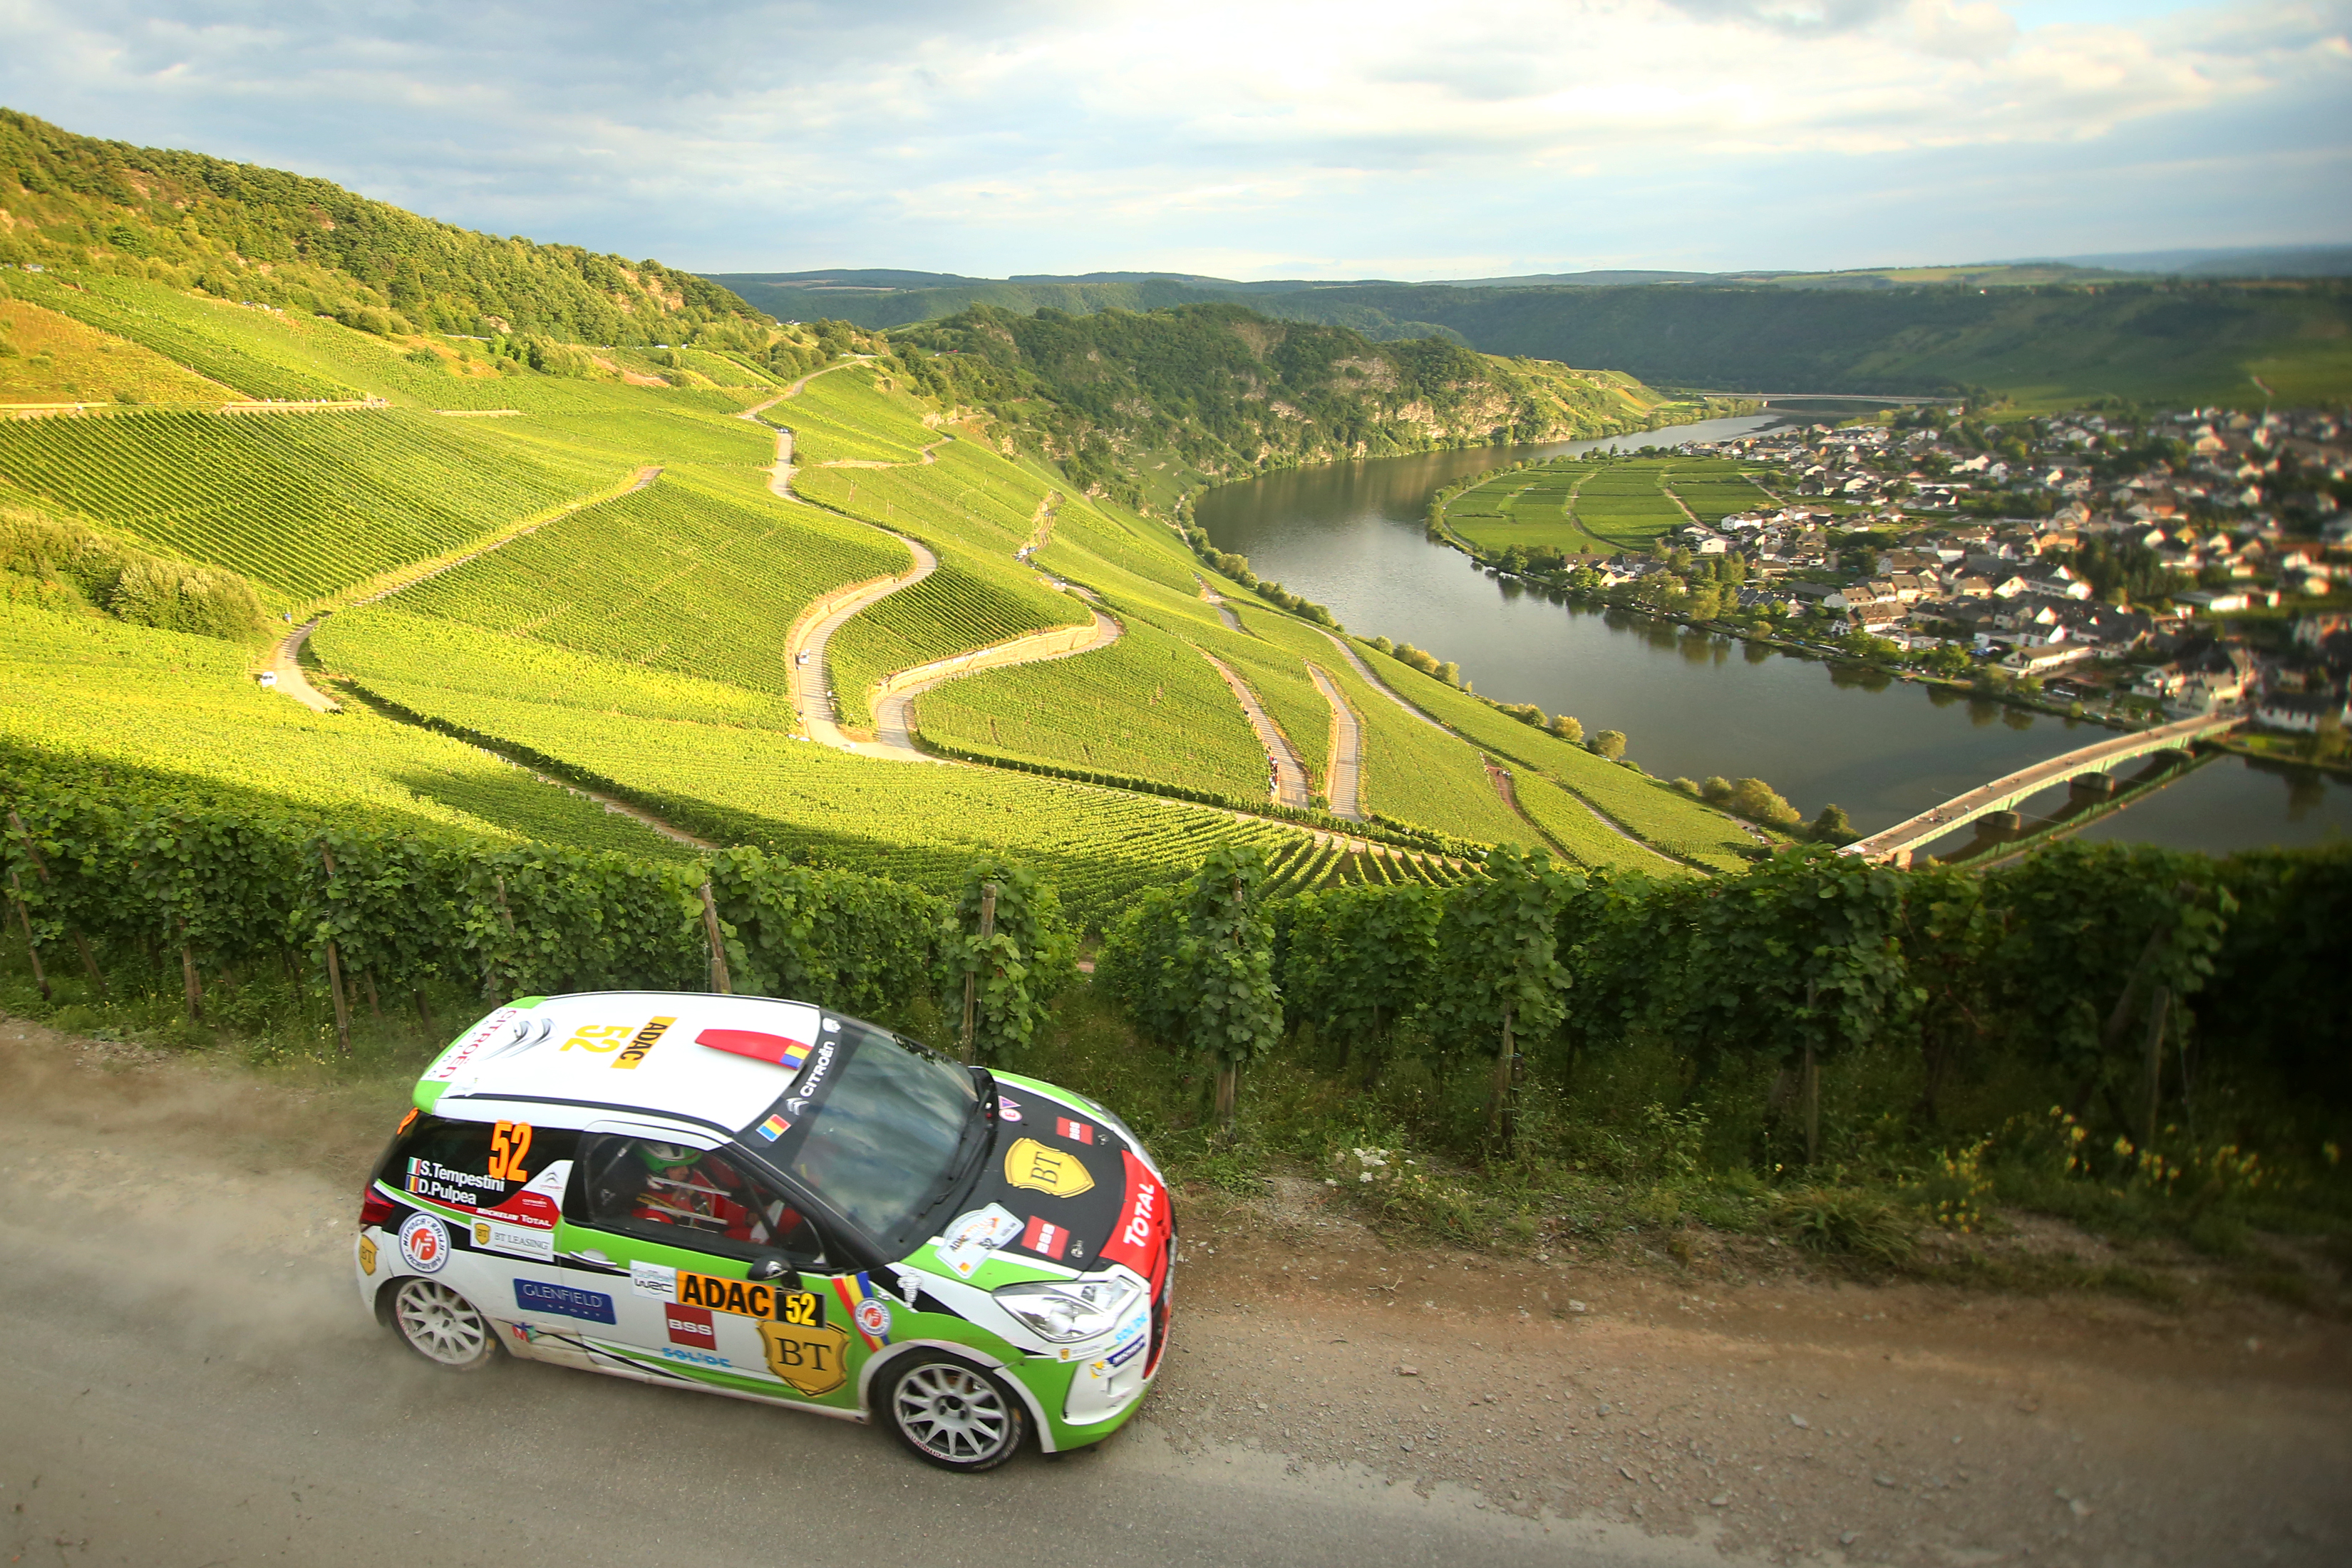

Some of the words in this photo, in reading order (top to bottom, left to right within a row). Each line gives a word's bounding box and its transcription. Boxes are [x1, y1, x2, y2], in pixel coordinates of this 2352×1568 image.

[559, 1025, 635, 1053] 52
[620, 1022, 668, 1061] ADAC
[488, 1119, 532, 1182] 52
[420, 1160, 505, 1192] S.Tempestini
[1029, 1151, 1062, 1187] BT
[418, 1179, 477, 1205] D.Pulpea
[520, 1214, 552, 1227] TOTAL
[1123, 1183, 1155, 1247] TOTAL
[361, 1246, 373, 1264] BT
[495, 1232, 506, 1242] BT
[507, 1234, 550, 1250] LEASING
[522, 1284, 603, 1308] GLENFIELD
[634, 1278, 674, 1293] WRC
[683, 1274, 770, 1316] ADAC
[785, 1293, 817, 1326] 52
[668, 1319, 713, 1336] BSS
[775, 1337, 832, 1371] BT
